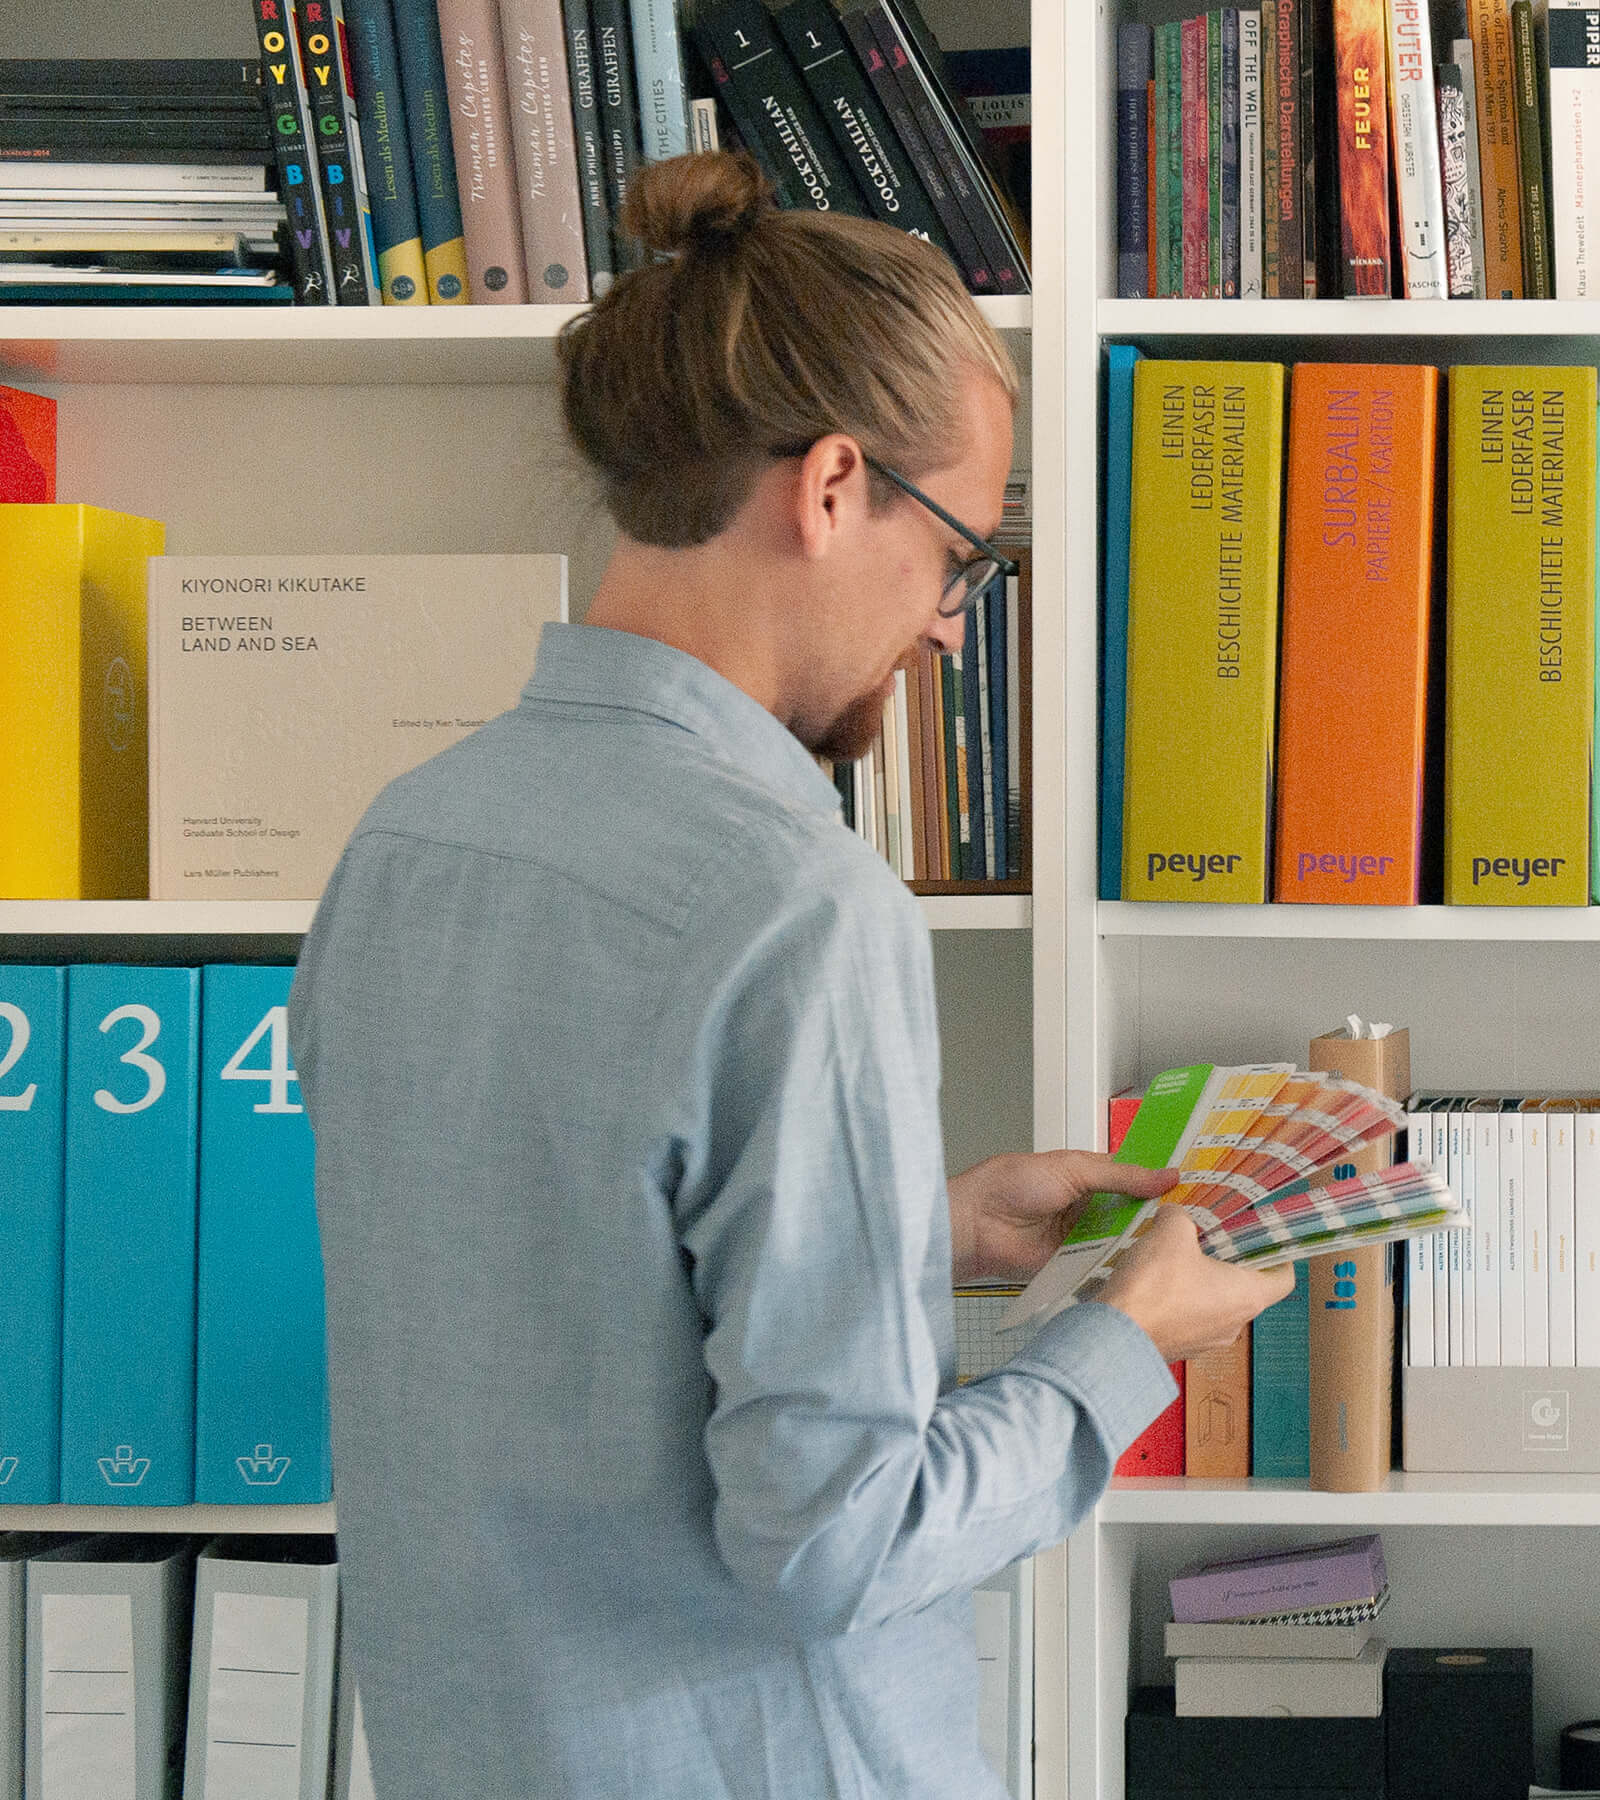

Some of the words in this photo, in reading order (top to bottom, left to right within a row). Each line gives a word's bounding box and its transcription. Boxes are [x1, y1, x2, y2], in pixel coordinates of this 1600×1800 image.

[733, 28, 750, 48] 1
[805, 29, 822, 49] 1
[1244, 19, 1257, 48] OFF
[1278, 2, 1294, 97] Graphische
[1519, 10, 1531, 46] NATURE
[1586, 14, 1600, 65] PIPER
[456, 30, 484, 119] Capotes
[516, 24, 544, 115] Capotes
[573, 28, 595, 109] GIRAFFEN
[601, 26, 622, 107] GIRAFFEN
[652, 78, 667, 124] CITIES
[1244, 55, 1257, 83] THE
[375, 90, 392, 144] Medizin
[422, 89, 439, 143] Medizin
[656, 128, 670, 157] THE
[1244, 89, 1257, 129] WALL
[1354, 66, 1372, 150] FEUER
[1400, 93, 1413, 138] CHRISTIAN
[383, 166, 397, 201] Lesen
[470, 125, 486, 203] Truman
[530, 123, 546, 200] Truman
[612, 128, 625, 174] PHILIPPI
[761, 95, 831, 212] COCKTAILIAN
[832, 96, 900, 213] COCKTAILIAN
[1279, 101, 1296, 221] Darstellungen
[1405, 141, 1416, 178] WURSTER
[1573, 111, 1584, 209] Männerphantasien
[1575, 215, 1584, 266] Theweleit
[1576, 268, 1586, 297] Klaus
[1162, 384, 1185, 459] LEINEN
[1191, 383, 1216, 510] LEDERFASER
[1220, 384, 1246, 523] MATERIALIEN
[1370, 388, 1394, 475] KARTON
[1481, 390, 1503, 464] LEINEN
[1511, 389, 1534, 514] LEDERFASER
[1542, 390, 1565, 527] MATERIALIEN
[1322, 388, 1360, 547] SURBALIN
[1364, 492, 1391, 582] PAPIERE
[181, 578, 272, 594] KIYONORI
[278, 577, 366, 593] KIKUTAKE
[1217, 531, 1243, 679] BESCHICHTETE
[1540, 536, 1564, 683] BESCHICHTETE
[181, 616, 273, 632] BETWEEN
[181, 637, 232, 652] LAND
[237, 637, 276, 652] AND
[281, 636, 319, 652] SEA
[1147, 852, 1242, 883] peyer
[1298, 852, 1394, 883] peyer
[1472, 856, 1566, 887] peyer
[94, 1004, 167, 1114] 3
[220, 1005, 304, 1114] 4
